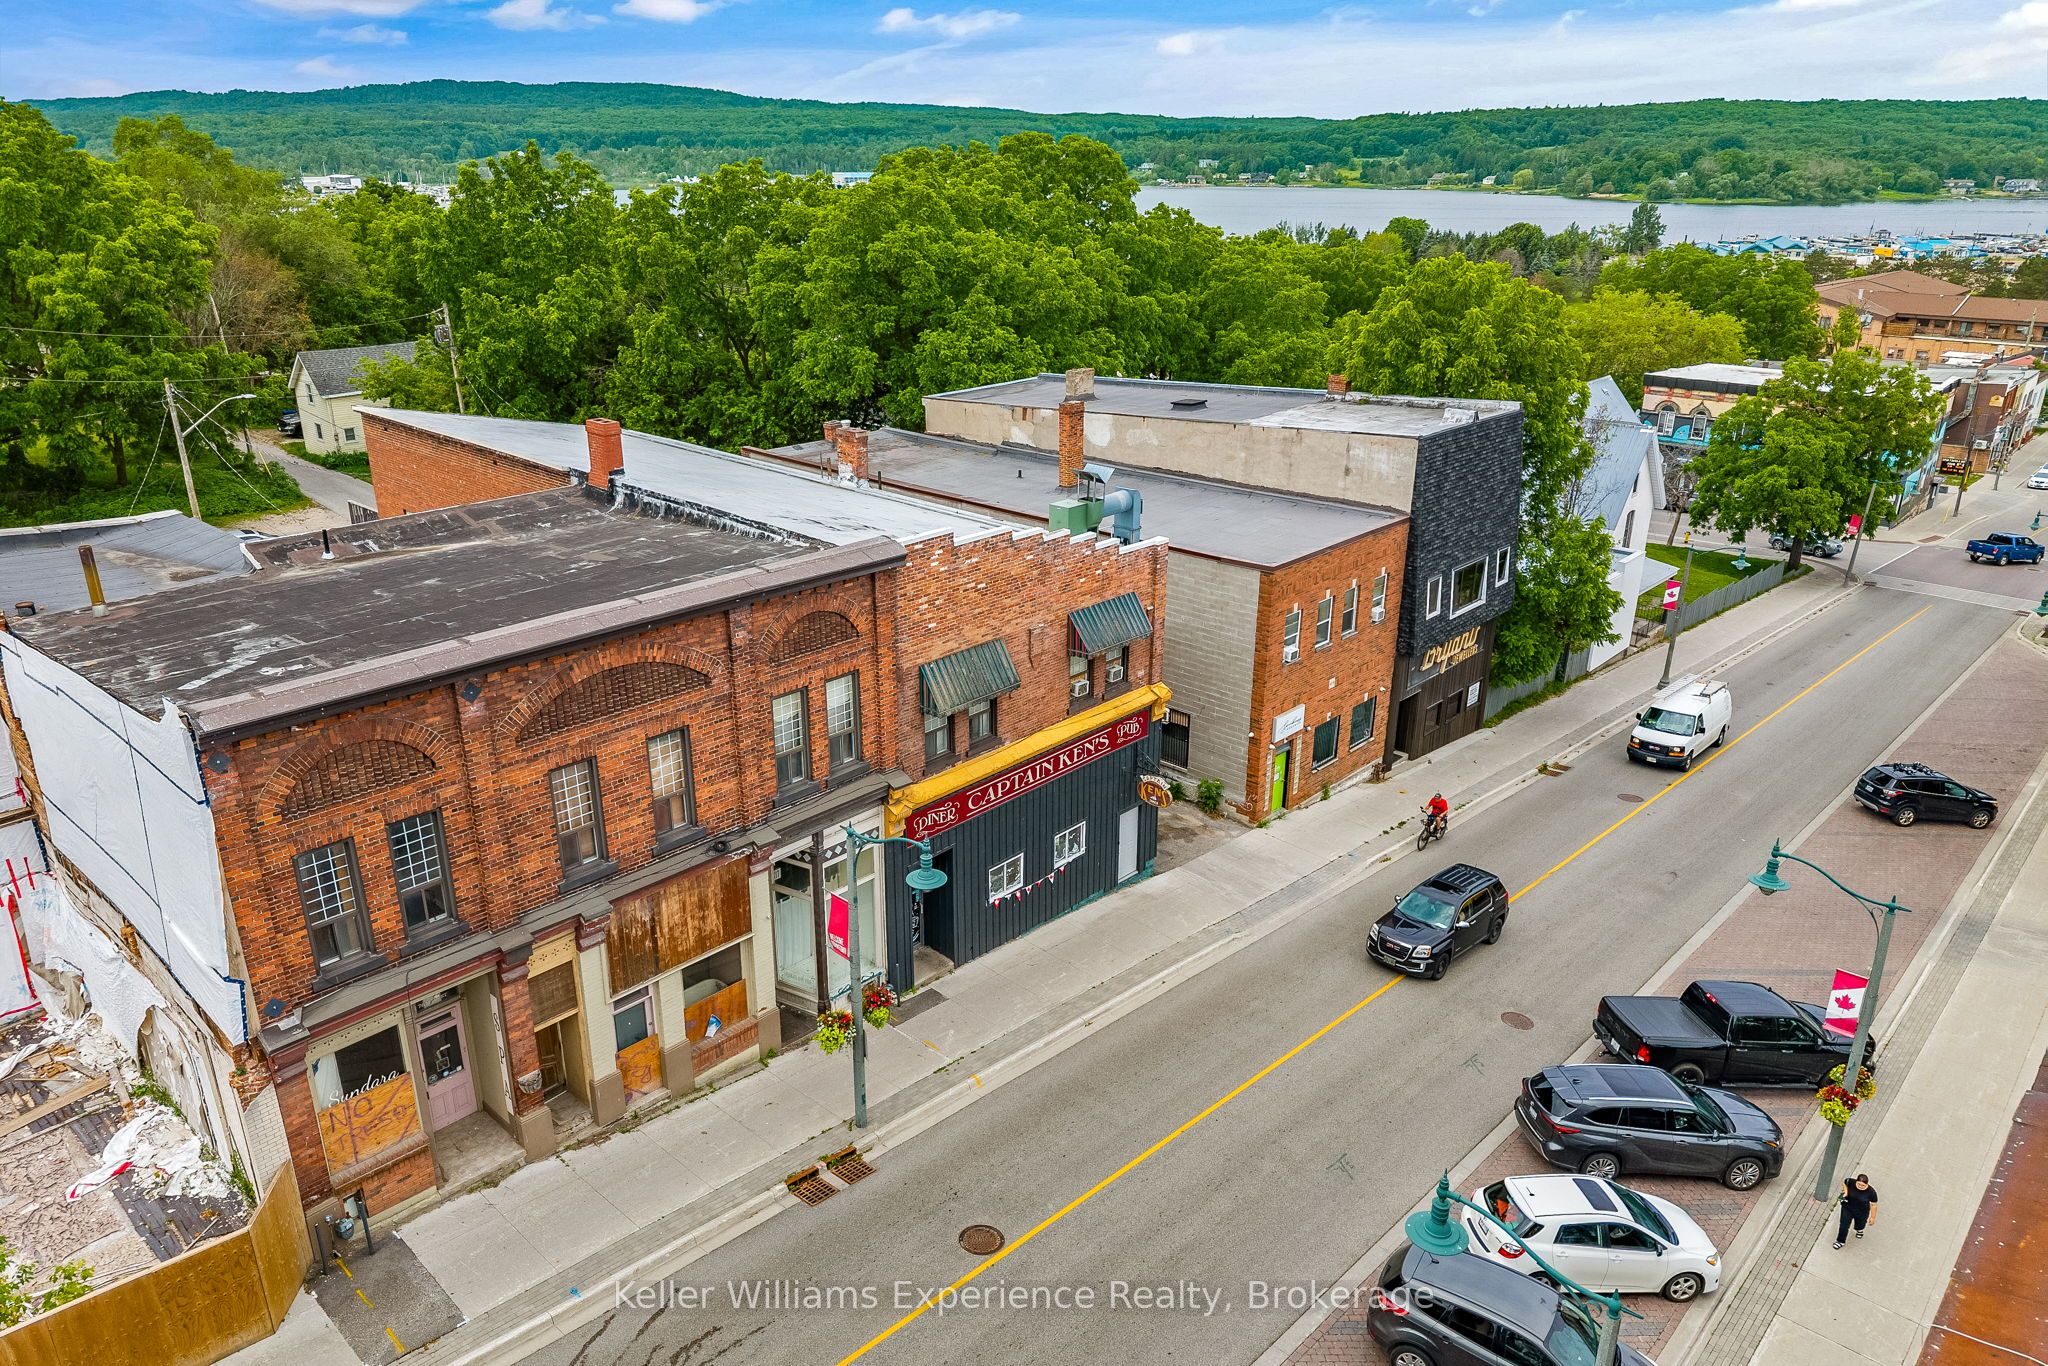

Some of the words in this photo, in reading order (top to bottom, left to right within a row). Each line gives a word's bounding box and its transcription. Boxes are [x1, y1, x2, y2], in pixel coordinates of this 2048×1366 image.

[914, 806, 957, 831] DINER
[968, 758, 1054, 810] CAPTAIN
[1058, 734, 1109, 770] KEN'S
[1117, 721, 1141, 737] PUB
[328, 1070, 400, 1108] Sundara
